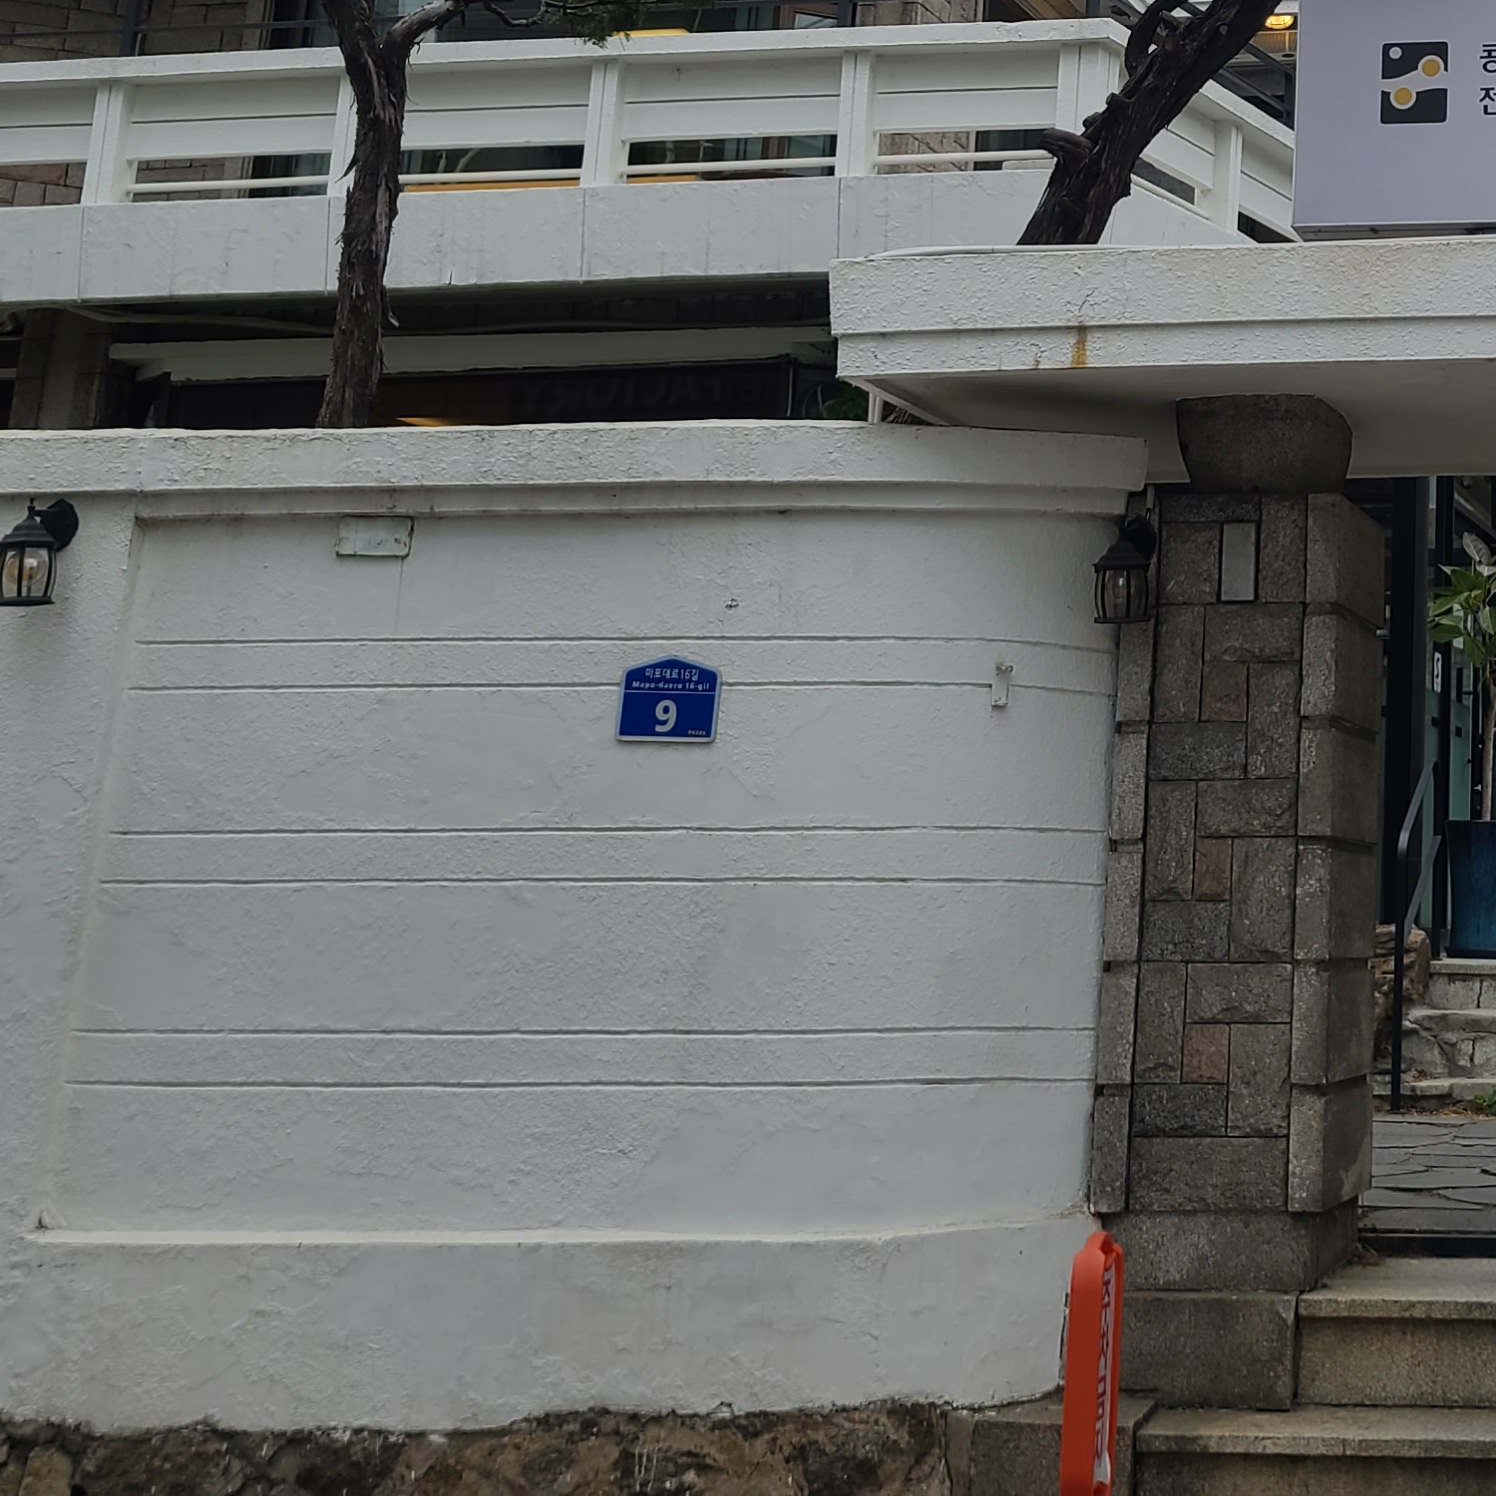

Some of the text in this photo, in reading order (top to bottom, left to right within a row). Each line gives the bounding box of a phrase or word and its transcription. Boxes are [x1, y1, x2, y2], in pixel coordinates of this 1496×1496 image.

[645, 668, 699, 681] 마포대로16길
[632, 681, 710, 691] Mapo-daero 16-gil
[655, 699, 677, 732] 9
